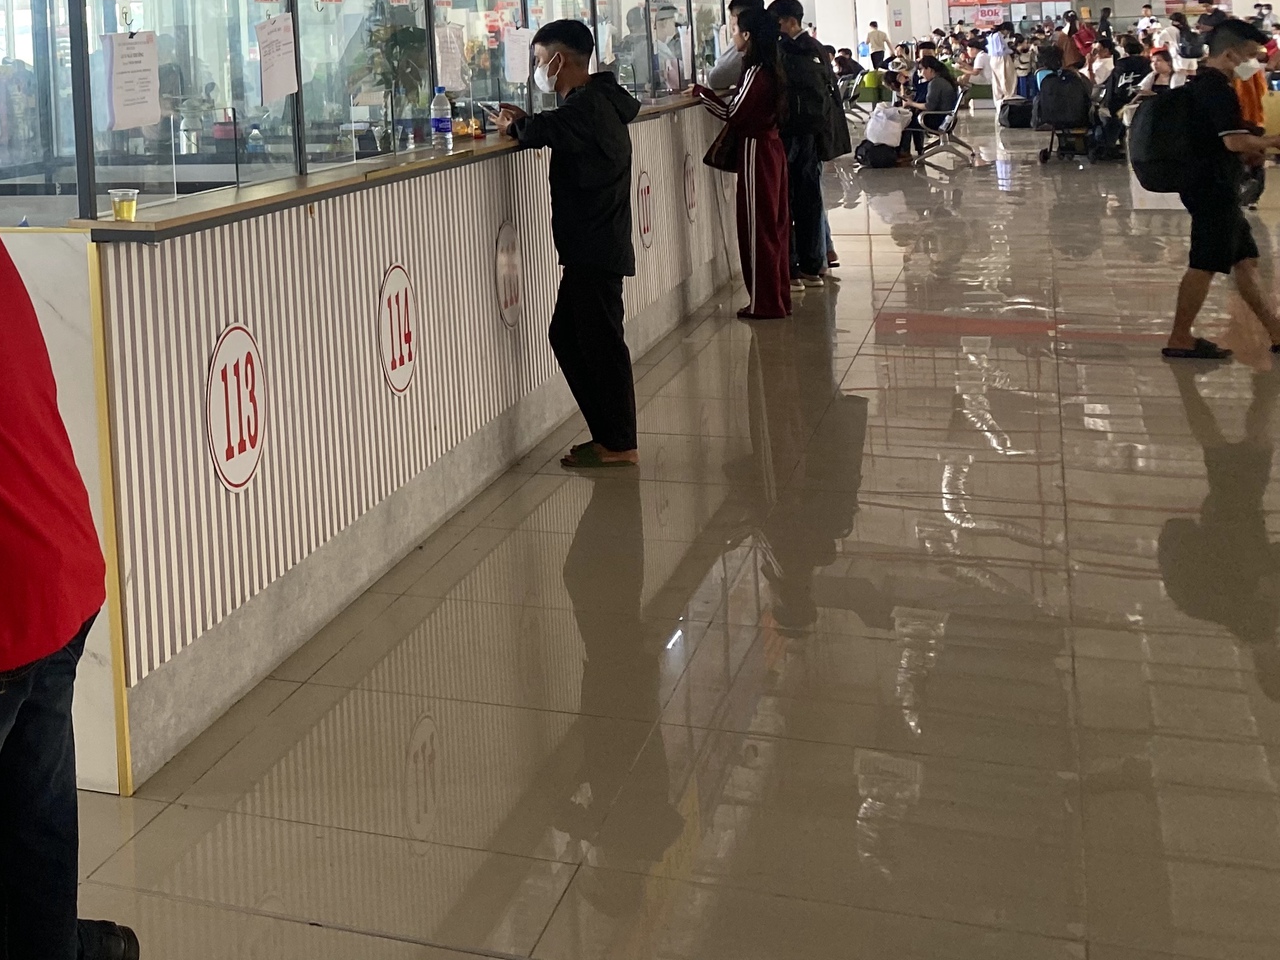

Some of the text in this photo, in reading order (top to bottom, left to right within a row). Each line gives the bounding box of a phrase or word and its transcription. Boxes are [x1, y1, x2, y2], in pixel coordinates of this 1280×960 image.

[980, 9, 1000, 17] 80k
[387, 287, 413, 371] 114
[221, 351, 258, 462] 113
